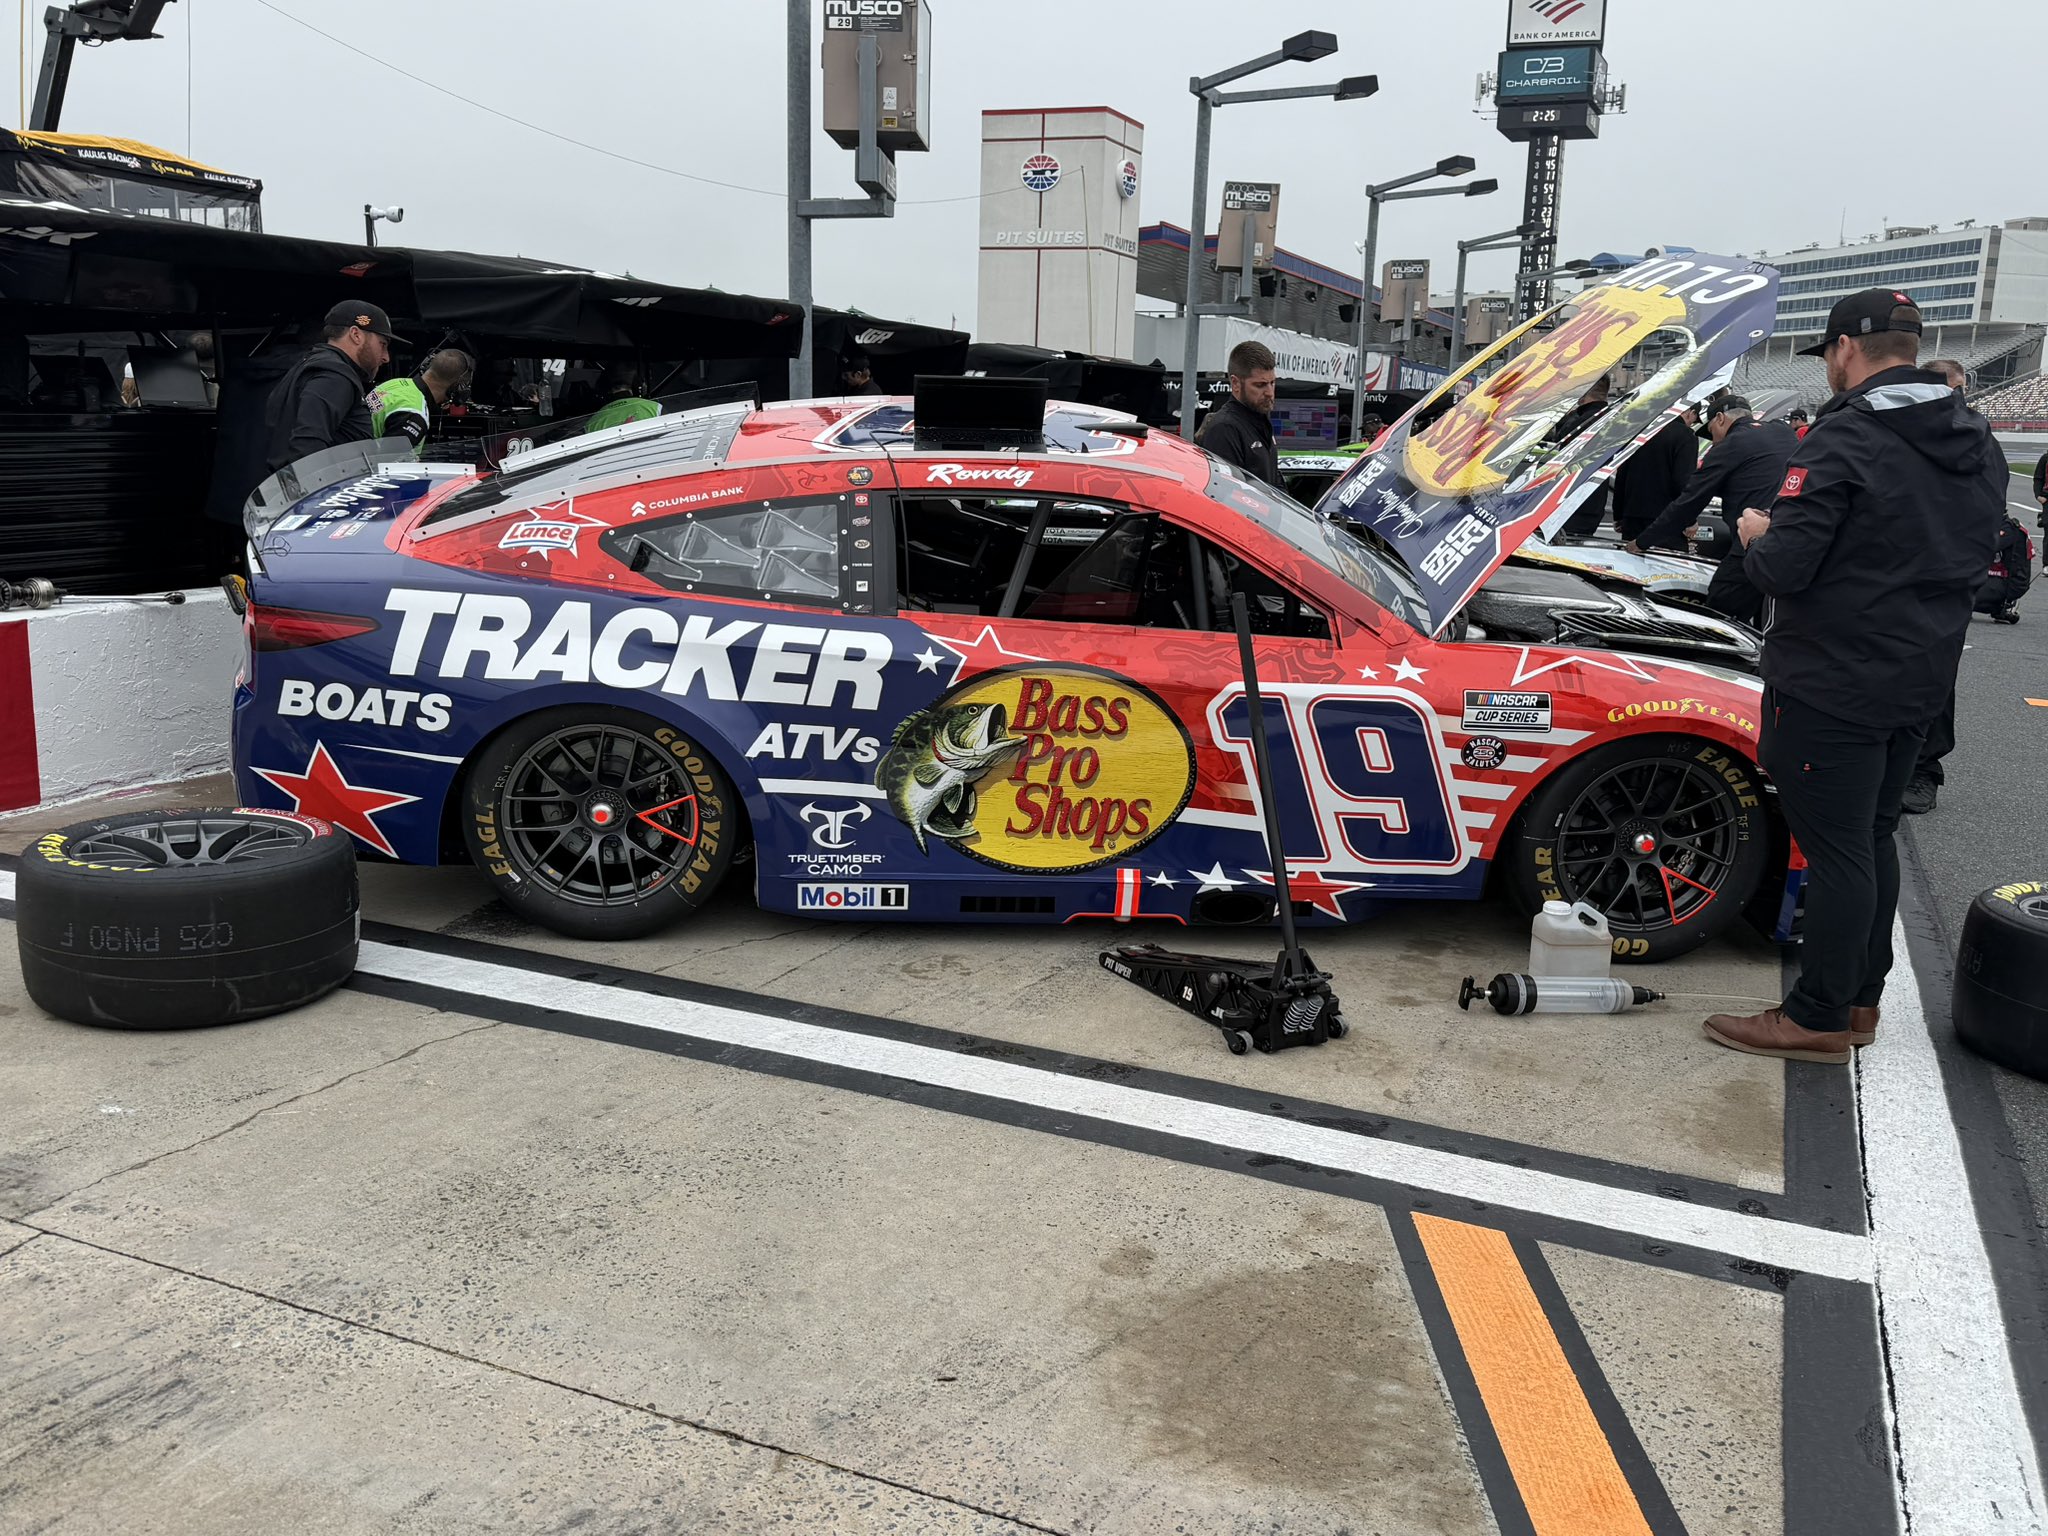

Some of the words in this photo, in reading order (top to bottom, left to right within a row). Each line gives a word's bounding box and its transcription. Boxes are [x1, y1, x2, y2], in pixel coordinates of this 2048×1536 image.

[837, 18, 851, 27] 29
[1514, 32, 1539, 40] BANK
[1555, 30, 1597, 39] AMERICA
[1506, 77, 1581, 88] CHARBROIL
[1532, 110, 1556, 122] 2:25
[1553, 135, 1559, 146] 9
[77, 149, 107, 159] KAULIG
[1535, 148, 1541, 156] 2
[1548, 146, 1558, 157] 10
[1534, 161, 1540, 169] 3
[1545, 159, 1556, 170] 45
[1533, 172, 1539, 180] 4
[1546, 171, 1556, 180] 11
[1532, 184, 1538, 193] 5
[1543, 183, 1555, 194] 54
[1531, 196, 1537, 204] 6
[1548, 194, 1553, 205] 5
[1531, 208, 1536, 216] 7
[1541, 206, 1552, 217] 23
[996, 231, 1023, 244] PIT
[1025, 230, 1085, 244] SUITES
[1103, 232, 1114, 247] PIT
[1114, 235, 1137, 253] SUITES
[1537, 253, 1548, 264] 67
[1521, 289, 1529, 297] 14
[1540, 288, 1546, 298] 3
[1534, 301, 1545, 311] 42
[1292, 353, 1300, 369] OF
[1300, 355, 1330, 376] AMERICA
[1208, 381, 1232, 393] xfin
[1363, 393, 1388, 403] finity
[1278, 457, 1336, 470] Rowdy
[926, 463, 1036, 487] Rowdy
[649, 492, 709, 509] COLUMBIA
[711, 486, 745, 498] BANK
[1476, 506, 1498, 525] YEARS
[507, 523, 573, 541] Lance
[1445, 513, 1493, 557] 250
[1419, 540, 1465, 586] USA
[384, 588, 894, 711] TRACKER
[277, 679, 452, 731] BOATS
[1008, 676, 1131, 736] Bass
[1492, 693, 1538, 707] NASCAR
[1475, 710, 1498, 722] CUP
[1499, 711, 1540, 723] SERIES
[1606, 698, 1755, 733] GOODYEAR
[745, 722, 881, 763] ATVs
[1469, 738, 1501, 749] NASCAR
[1008, 733, 1100, 785] Pro
[1465, 757, 1500, 768] SALUTES
[1206, 681, 1471, 876] 19
[1695, 746, 1760, 809] EAGLE
[654, 727, 723, 894] GOODYEAR
[1005, 782, 1153, 851] Shops
[788, 854, 882, 863] TRUETIMBER
[807, 864, 862, 875] CAMO
[801, 886, 875, 907] Mobil
[887, 888, 897, 906] 1
[1104, 957, 1114, 970] PIT
[1114, 961, 1133, 979] VIPER
[1182, 986, 1194, 1001] 19
